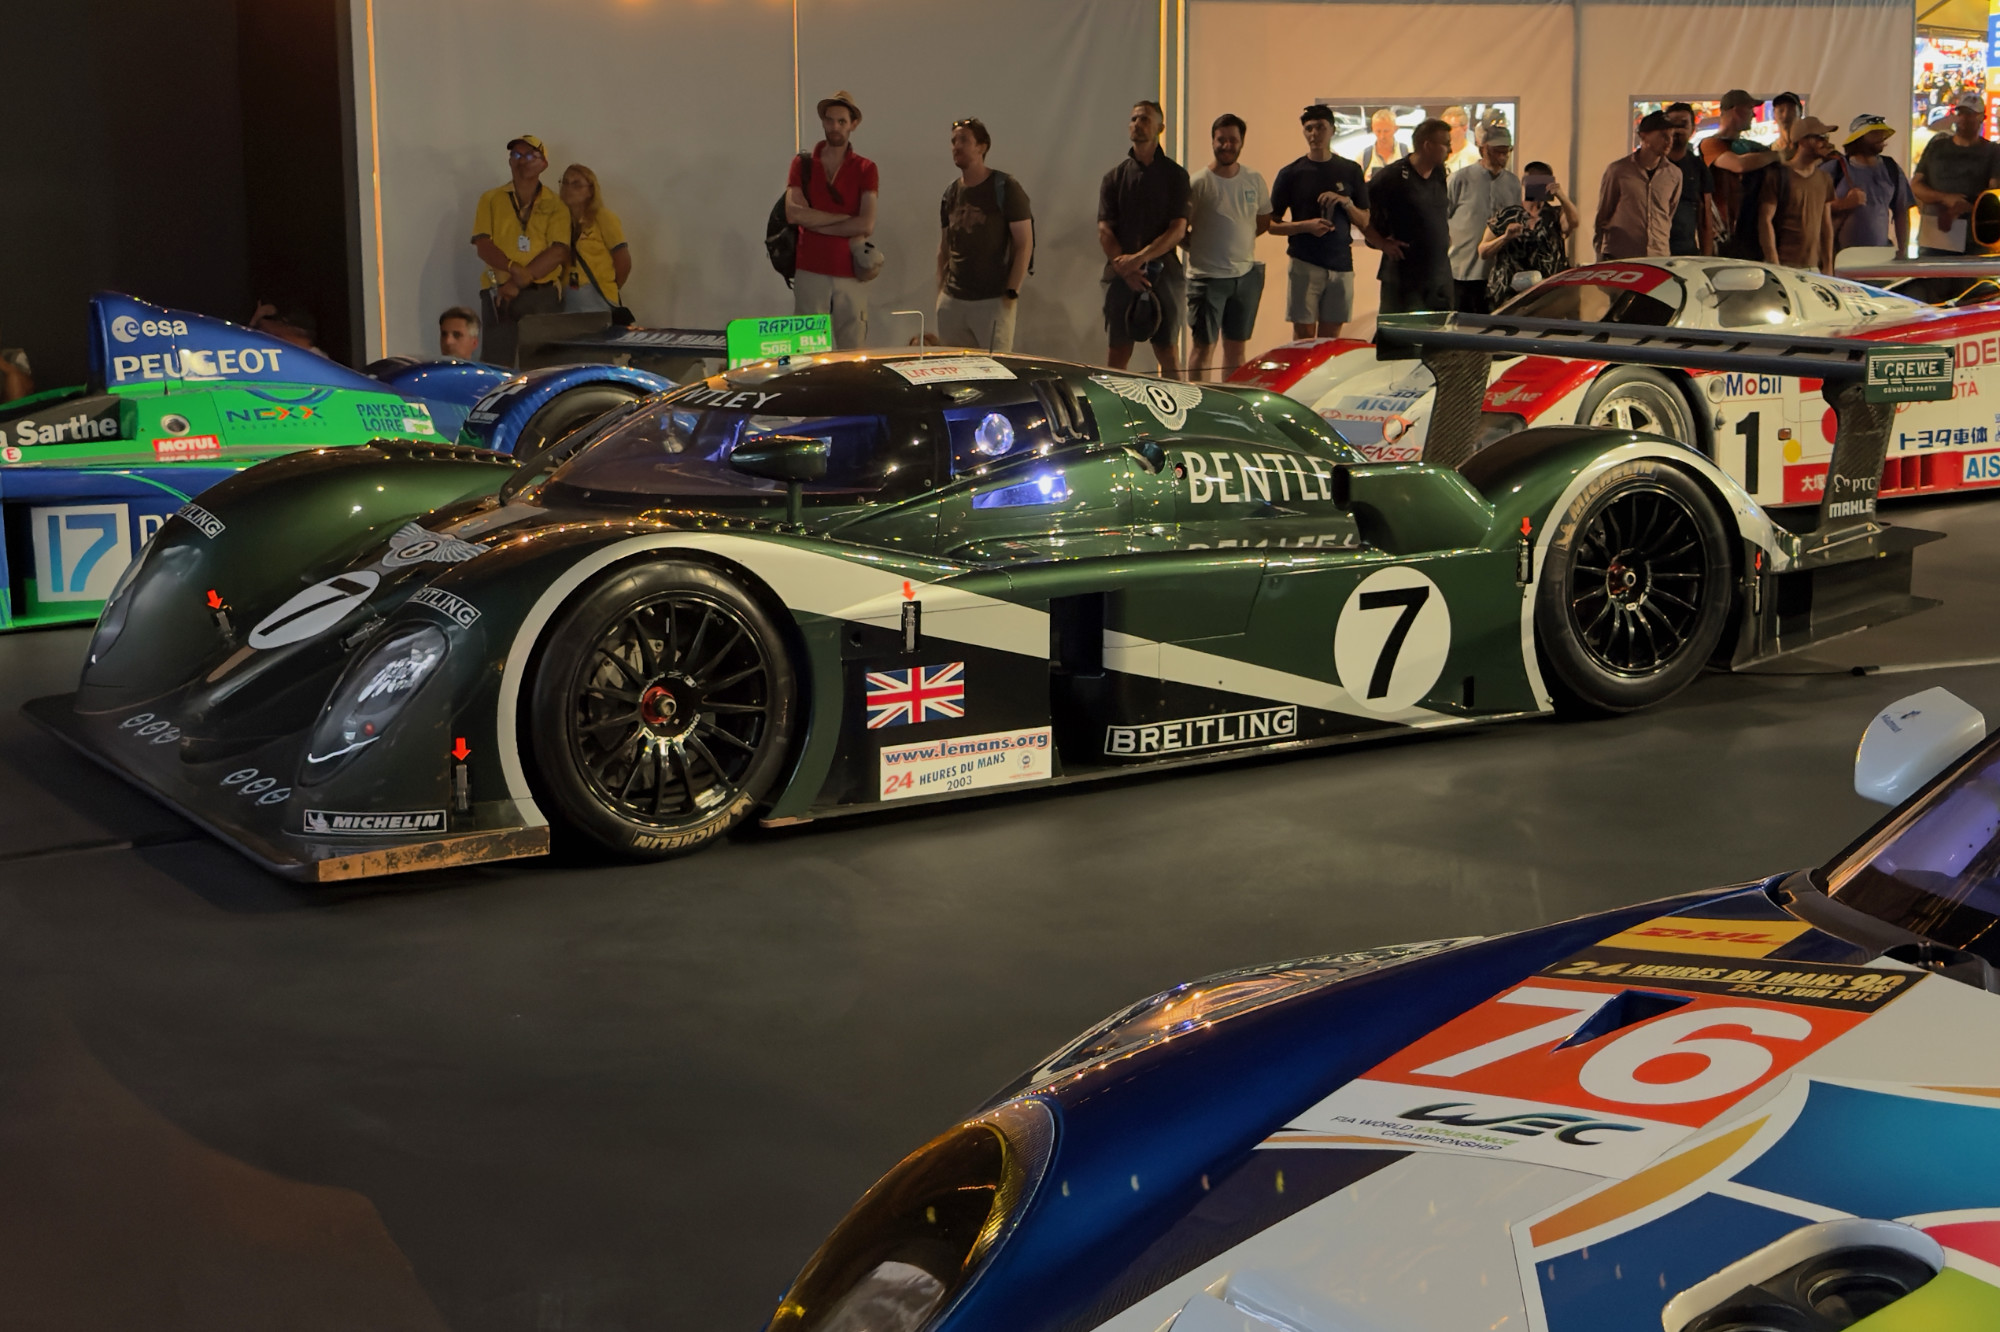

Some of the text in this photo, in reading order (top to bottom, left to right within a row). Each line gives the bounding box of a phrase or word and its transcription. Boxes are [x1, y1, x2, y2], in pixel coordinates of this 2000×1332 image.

[142, 320, 188, 336] esa
[113, 348, 282, 381] PEUGEOT
[1954, 337, 2000, 368] IDE
[1884, 361, 1939, 377] CREWE
[1726, 374, 1782, 396] Mobil
[356, 403, 391, 417] PAYS
[389, 404, 408, 418] DE
[16, 414, 118, 446] Sarthe
[362, 417, 404, 432] LOIRE
[157, 437, 217, 453] MOTUL
[1900, 426, 1988, 450] トヨタ車体
[1355, 445, 1420, 461] ENSO
[1736, 411, 1760, 494] 1
[1568, 460, 1656, 521] MICHELIN
[1829, 498, 1875, 518] MAHLE
[48, 512, 119, 592] 17
[1359, 586, 1430, 700] 7
[1112, 709, 1294, 753] BREITLING
[885, 733, 1049, 764] www.lemans.org
[883, 752, 1006, 796] 24 HEURES DU MANS
[946, 775, 973, 791] 2003
[332, 814, 440, 829] MICHELIN
[633, 813, 732, 849] MICHELIN
[1636, 927, 1774, 944] DHL
[1553, 961, 1631, 977] 24
[1625, 964, 1728, 979] HEURES
[1722, 969, 1772, 982] DU
[1765, 972, 1854, 987] MANS
[1783, 986, 1834, 999] JUIN
[1408, 986, 1813, 1104] 76
[1330, 1115, 1520, 1146] FIA WORLD ENDURANCE
[1397, 1102, 1645, 1146] WEC
[1381, 1129, 1503, 1151] CHAMPIONSHIP
